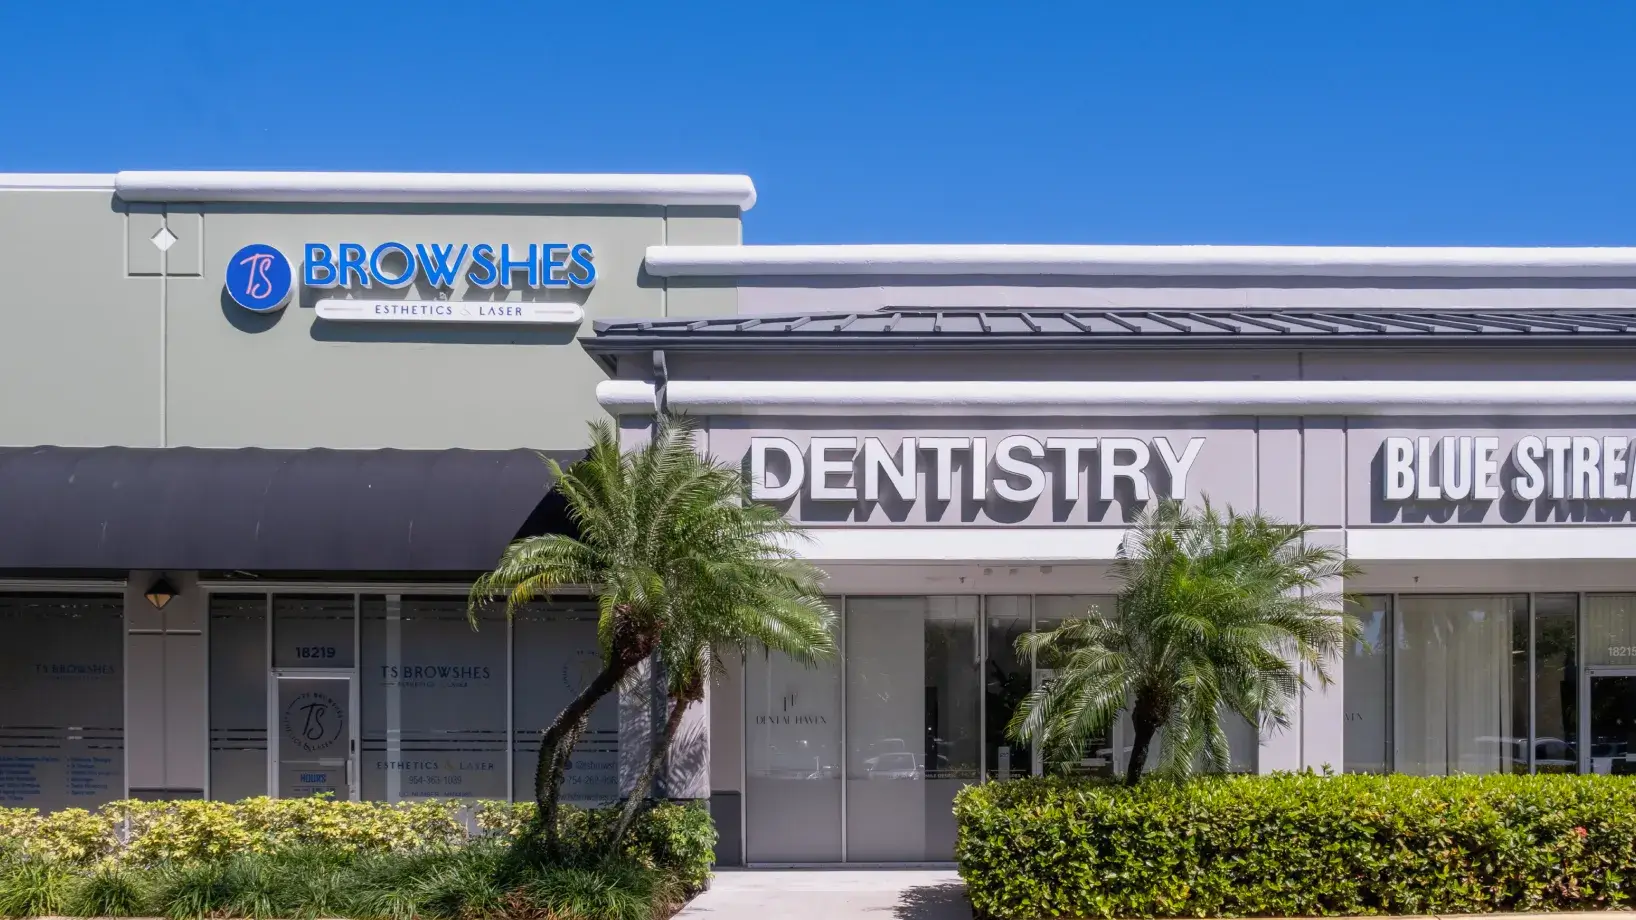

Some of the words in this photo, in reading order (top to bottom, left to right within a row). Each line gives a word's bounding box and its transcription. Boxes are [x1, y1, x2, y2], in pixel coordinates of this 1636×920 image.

[240, 253, 272, 299] TS
[304, 241, 597, 287] BROWSHES
[374, 304, 453, 316] ESTHETICS
[479, 305, 523, 317] LASER
[750, 434, 1206, 502] DENTISTRY
[1386, 435, 1500, 500] BLUE
[1515, 434, 1636, 500] STRE
[295, 646, 336, 659] 18219
[380, 665, 398, 679] TS
[404, 665, 491, 679] BROWSHES
[756, 715, 792, 725] DENTAL
[795, 715, 827, 725] HAVEN
[376, 760, 437, 770] ESTHETICS
[460, 761, 494, 771] LASER
[300, 773, 327, 784] HOURS
